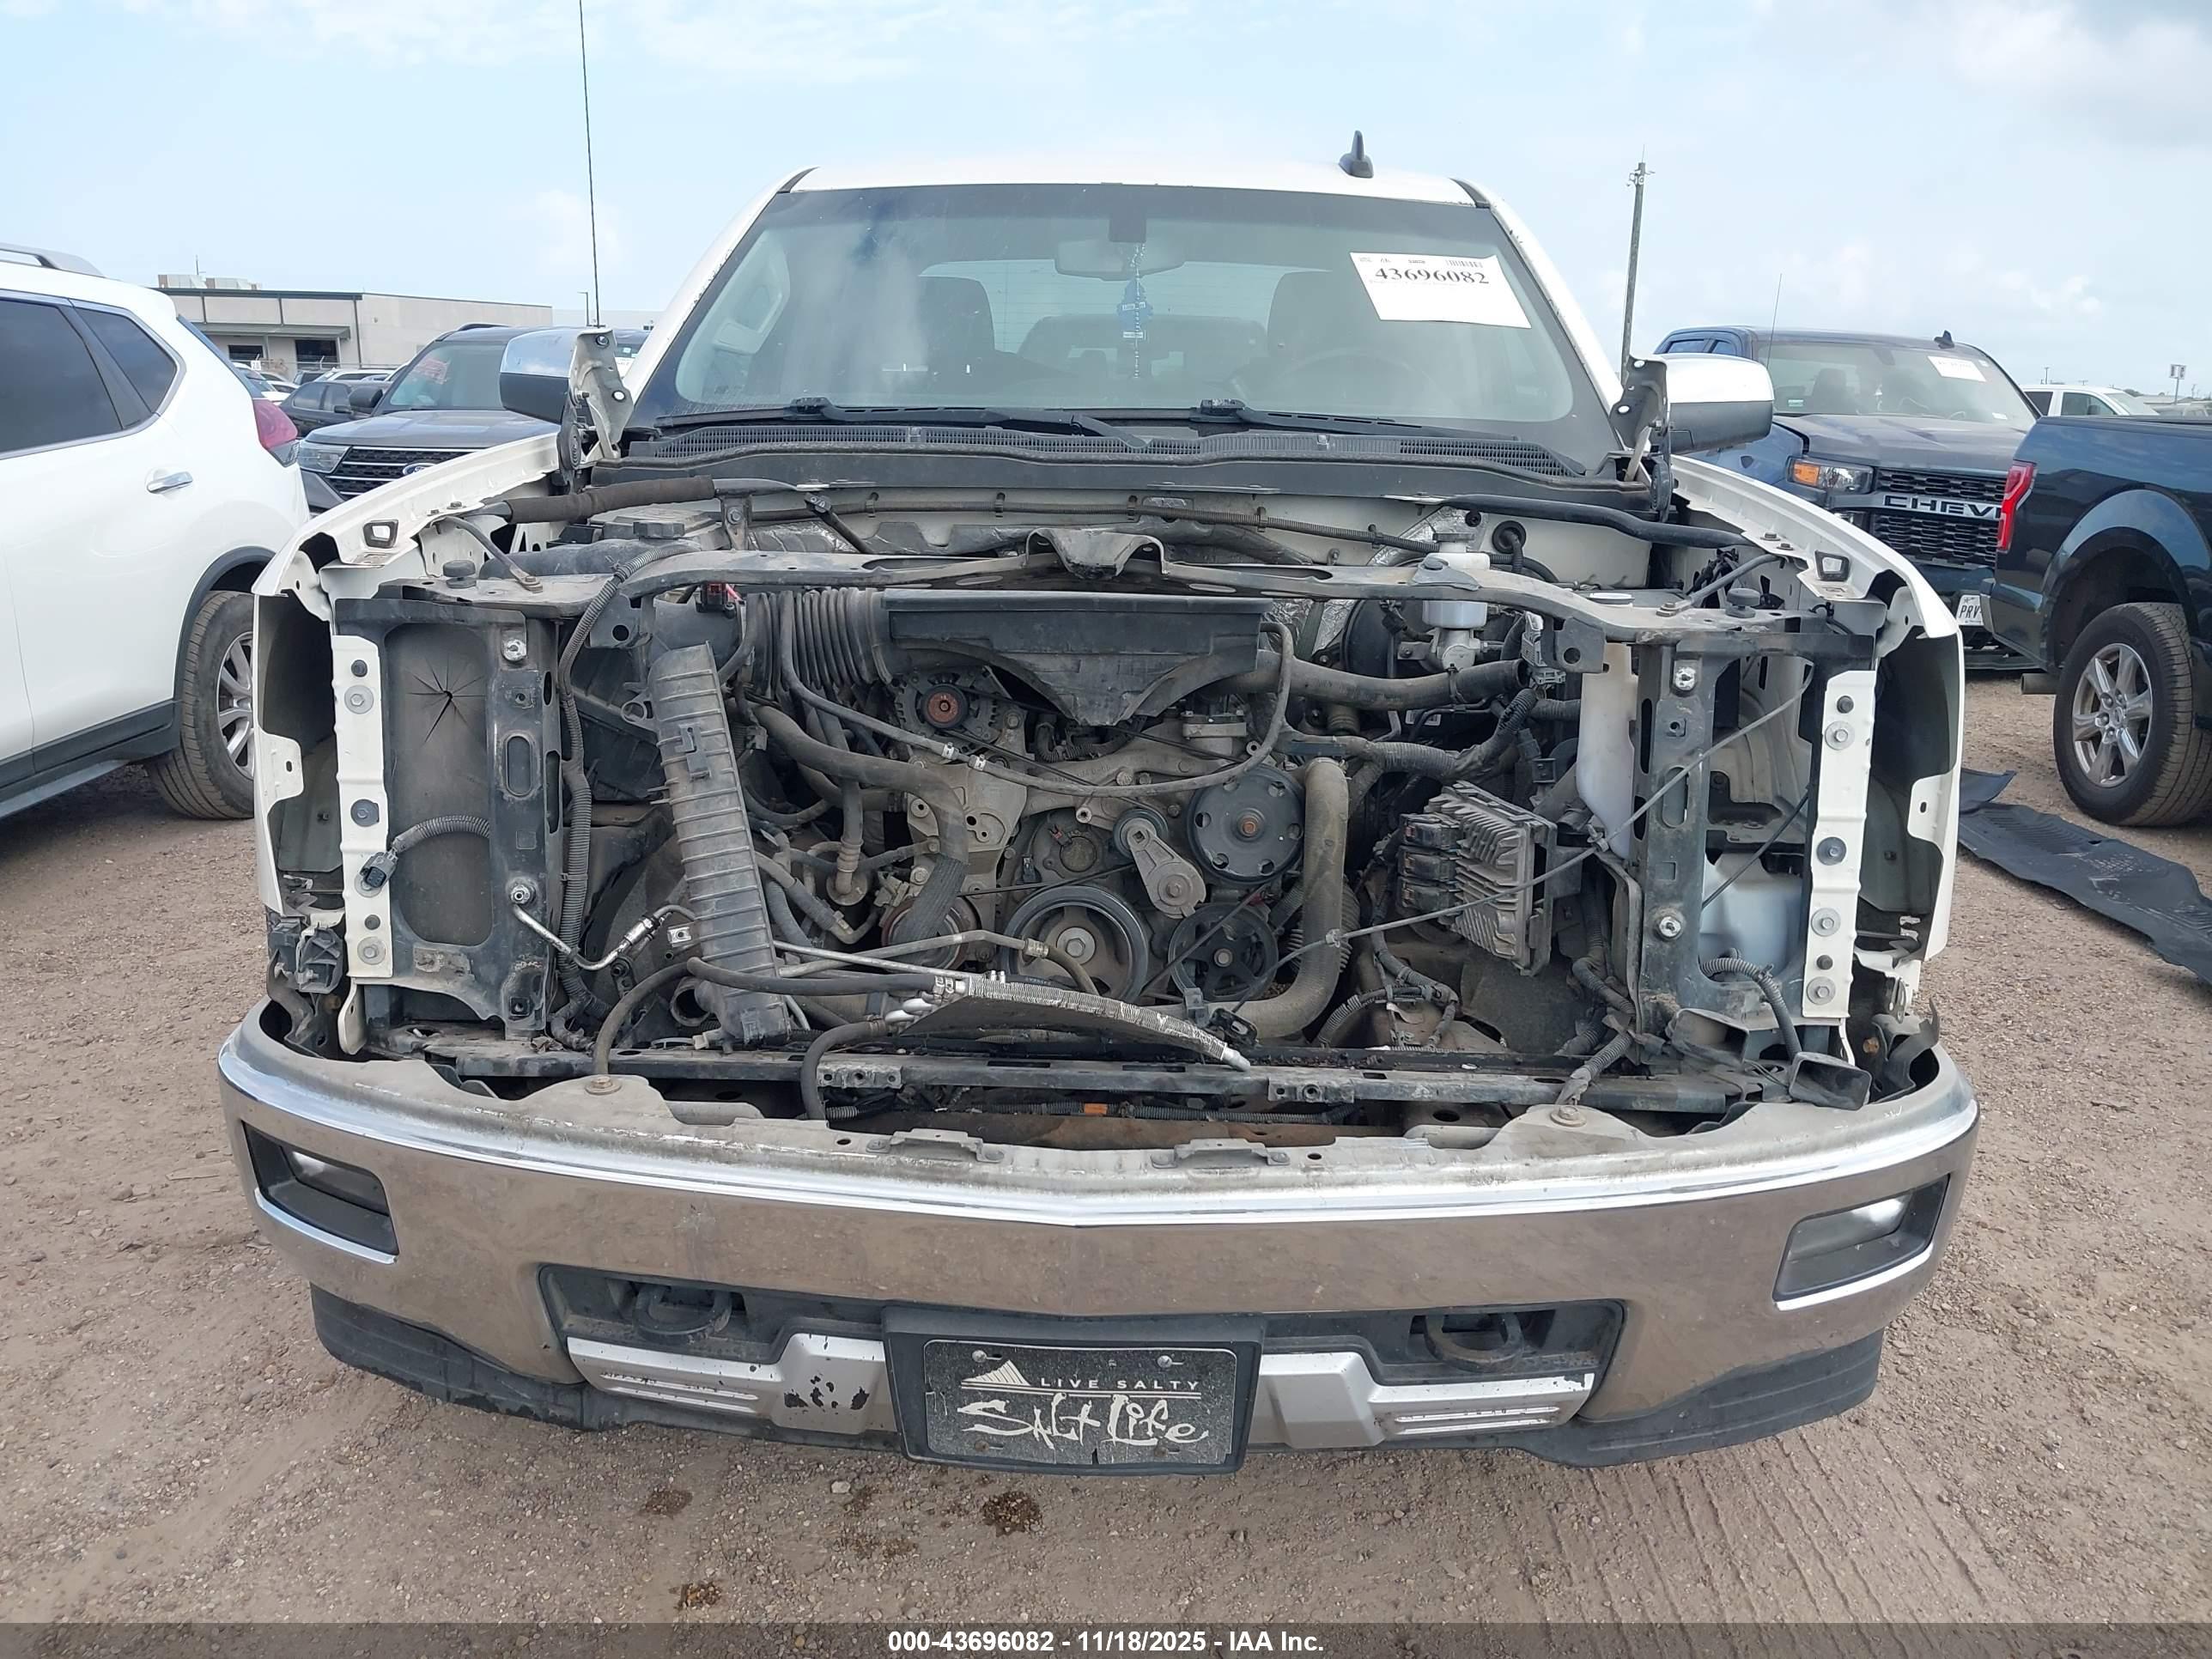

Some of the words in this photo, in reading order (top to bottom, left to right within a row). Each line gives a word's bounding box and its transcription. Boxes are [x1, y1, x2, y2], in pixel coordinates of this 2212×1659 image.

[1375, 267, 1489, 284] 43696082
[1041, 1377, 1099, 1389] LIVE
[1117, 1380, 1199, 1390] SALTY
[1101, 1394, 1209, 1446] Life
